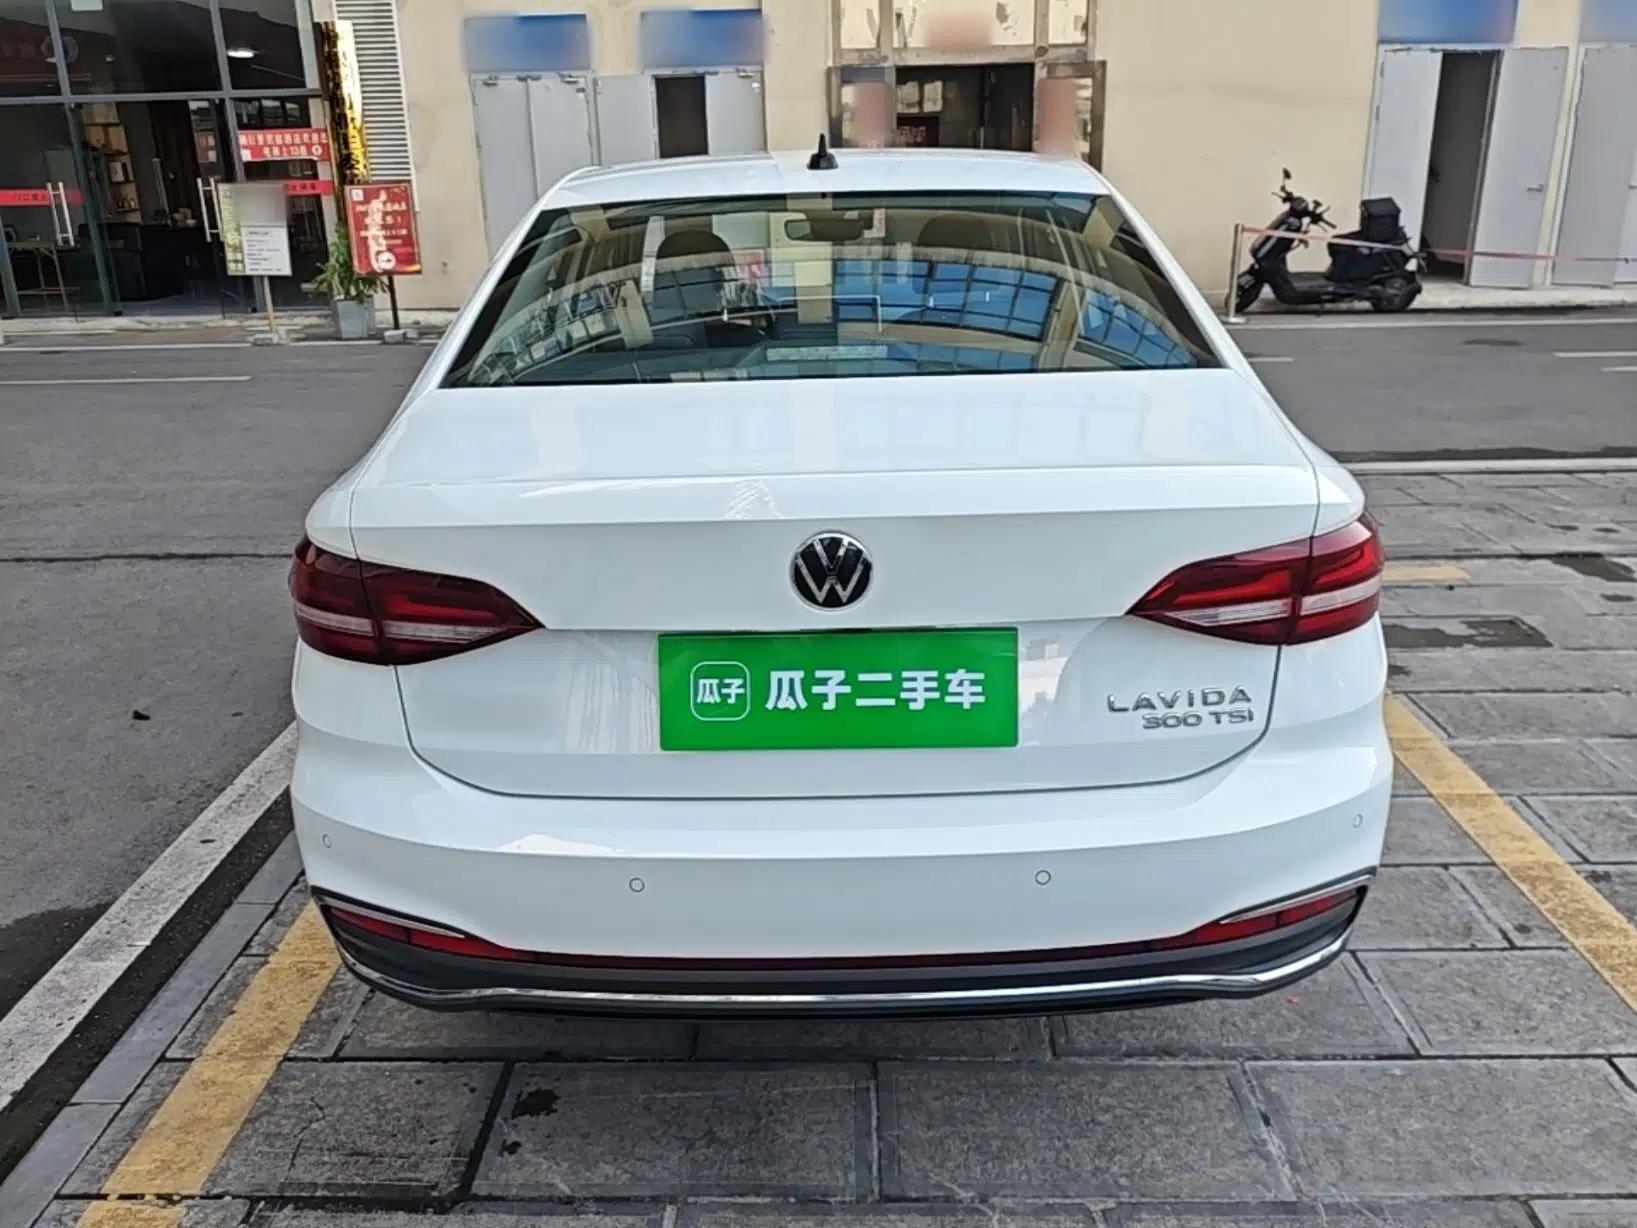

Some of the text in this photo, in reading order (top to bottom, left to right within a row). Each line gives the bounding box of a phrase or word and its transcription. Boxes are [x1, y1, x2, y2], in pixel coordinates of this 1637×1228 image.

[696, 678, 746, 705] 瓜子
[765, 668, 986, 711] 瓜子二手车
[1106, 685, 1252, 713] LAVIDA
[1142, 707, 1255, 729] 300 TSI
